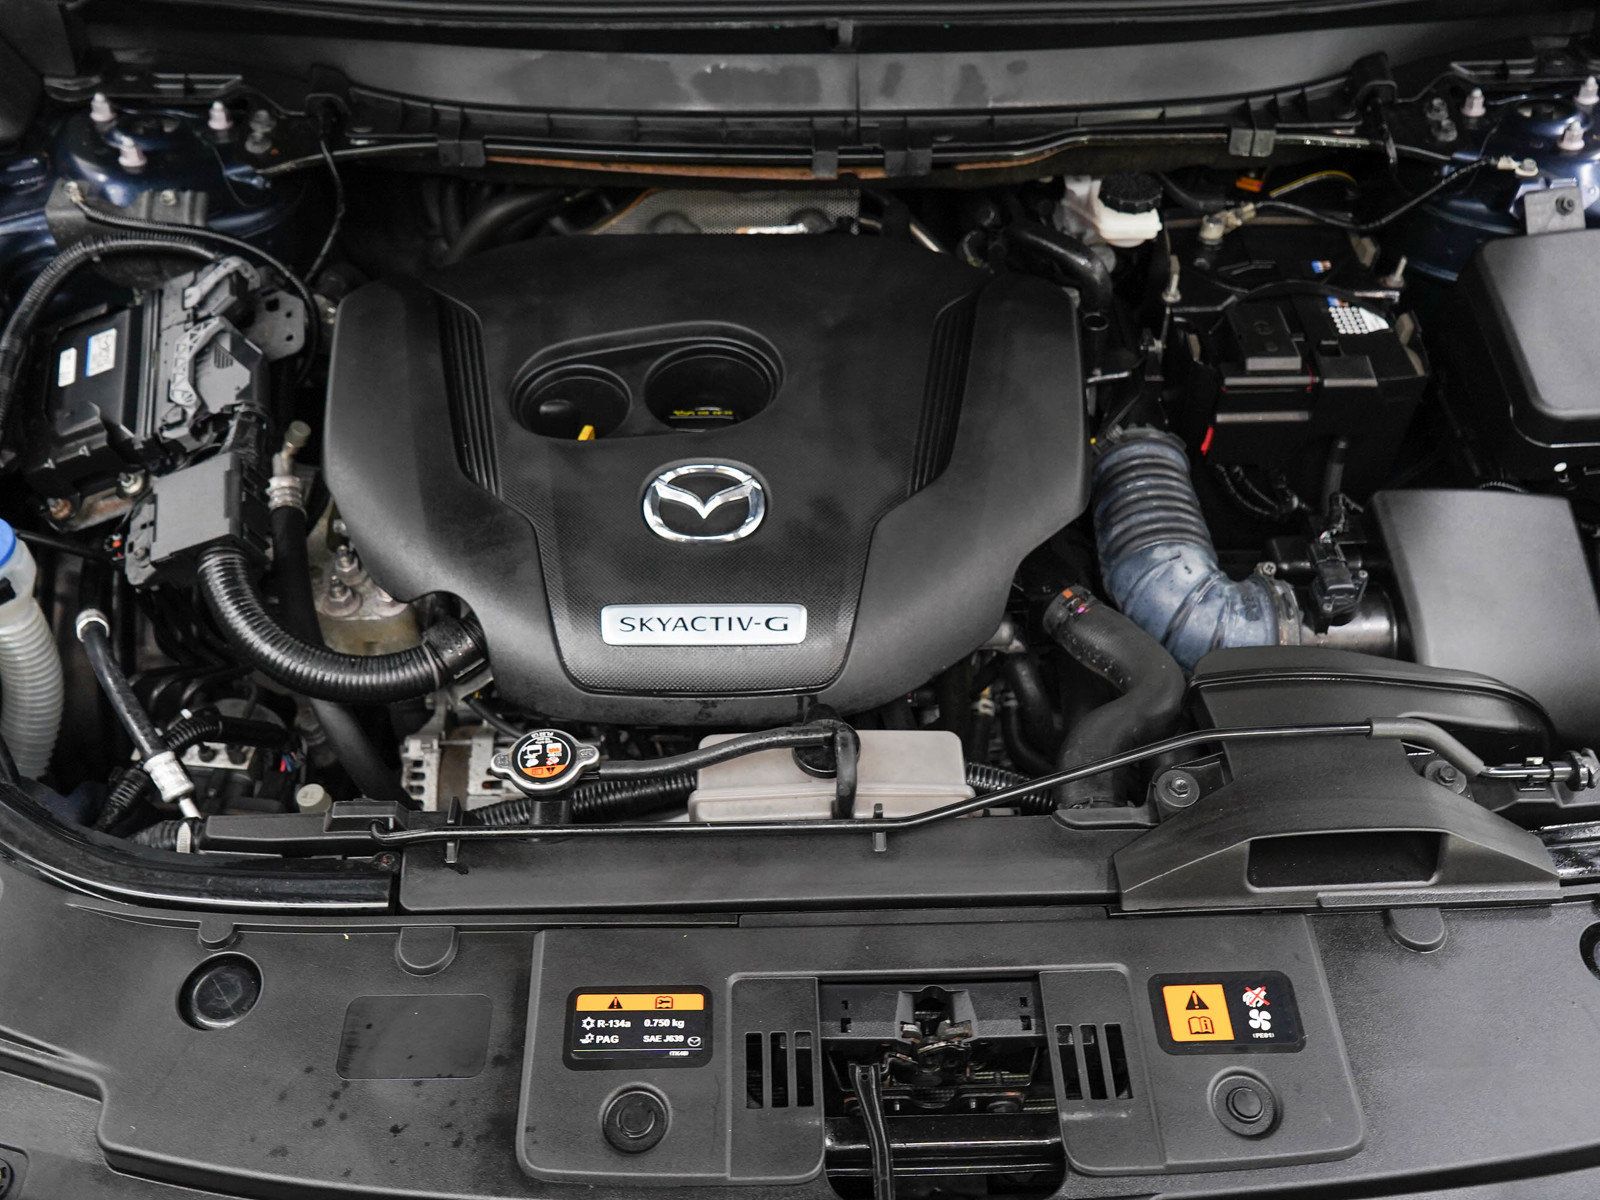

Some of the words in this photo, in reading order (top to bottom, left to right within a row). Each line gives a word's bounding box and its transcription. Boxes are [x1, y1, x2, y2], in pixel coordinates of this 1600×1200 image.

[619, 616, 789, 633] SKYACTIV-G
[597, 1019, 631, 1028] R-134a
[671, 1019, 685, 1029] kg
[596, 1035, 620, 1044] PAG
[643, 1035, 662, 1043] SAE
